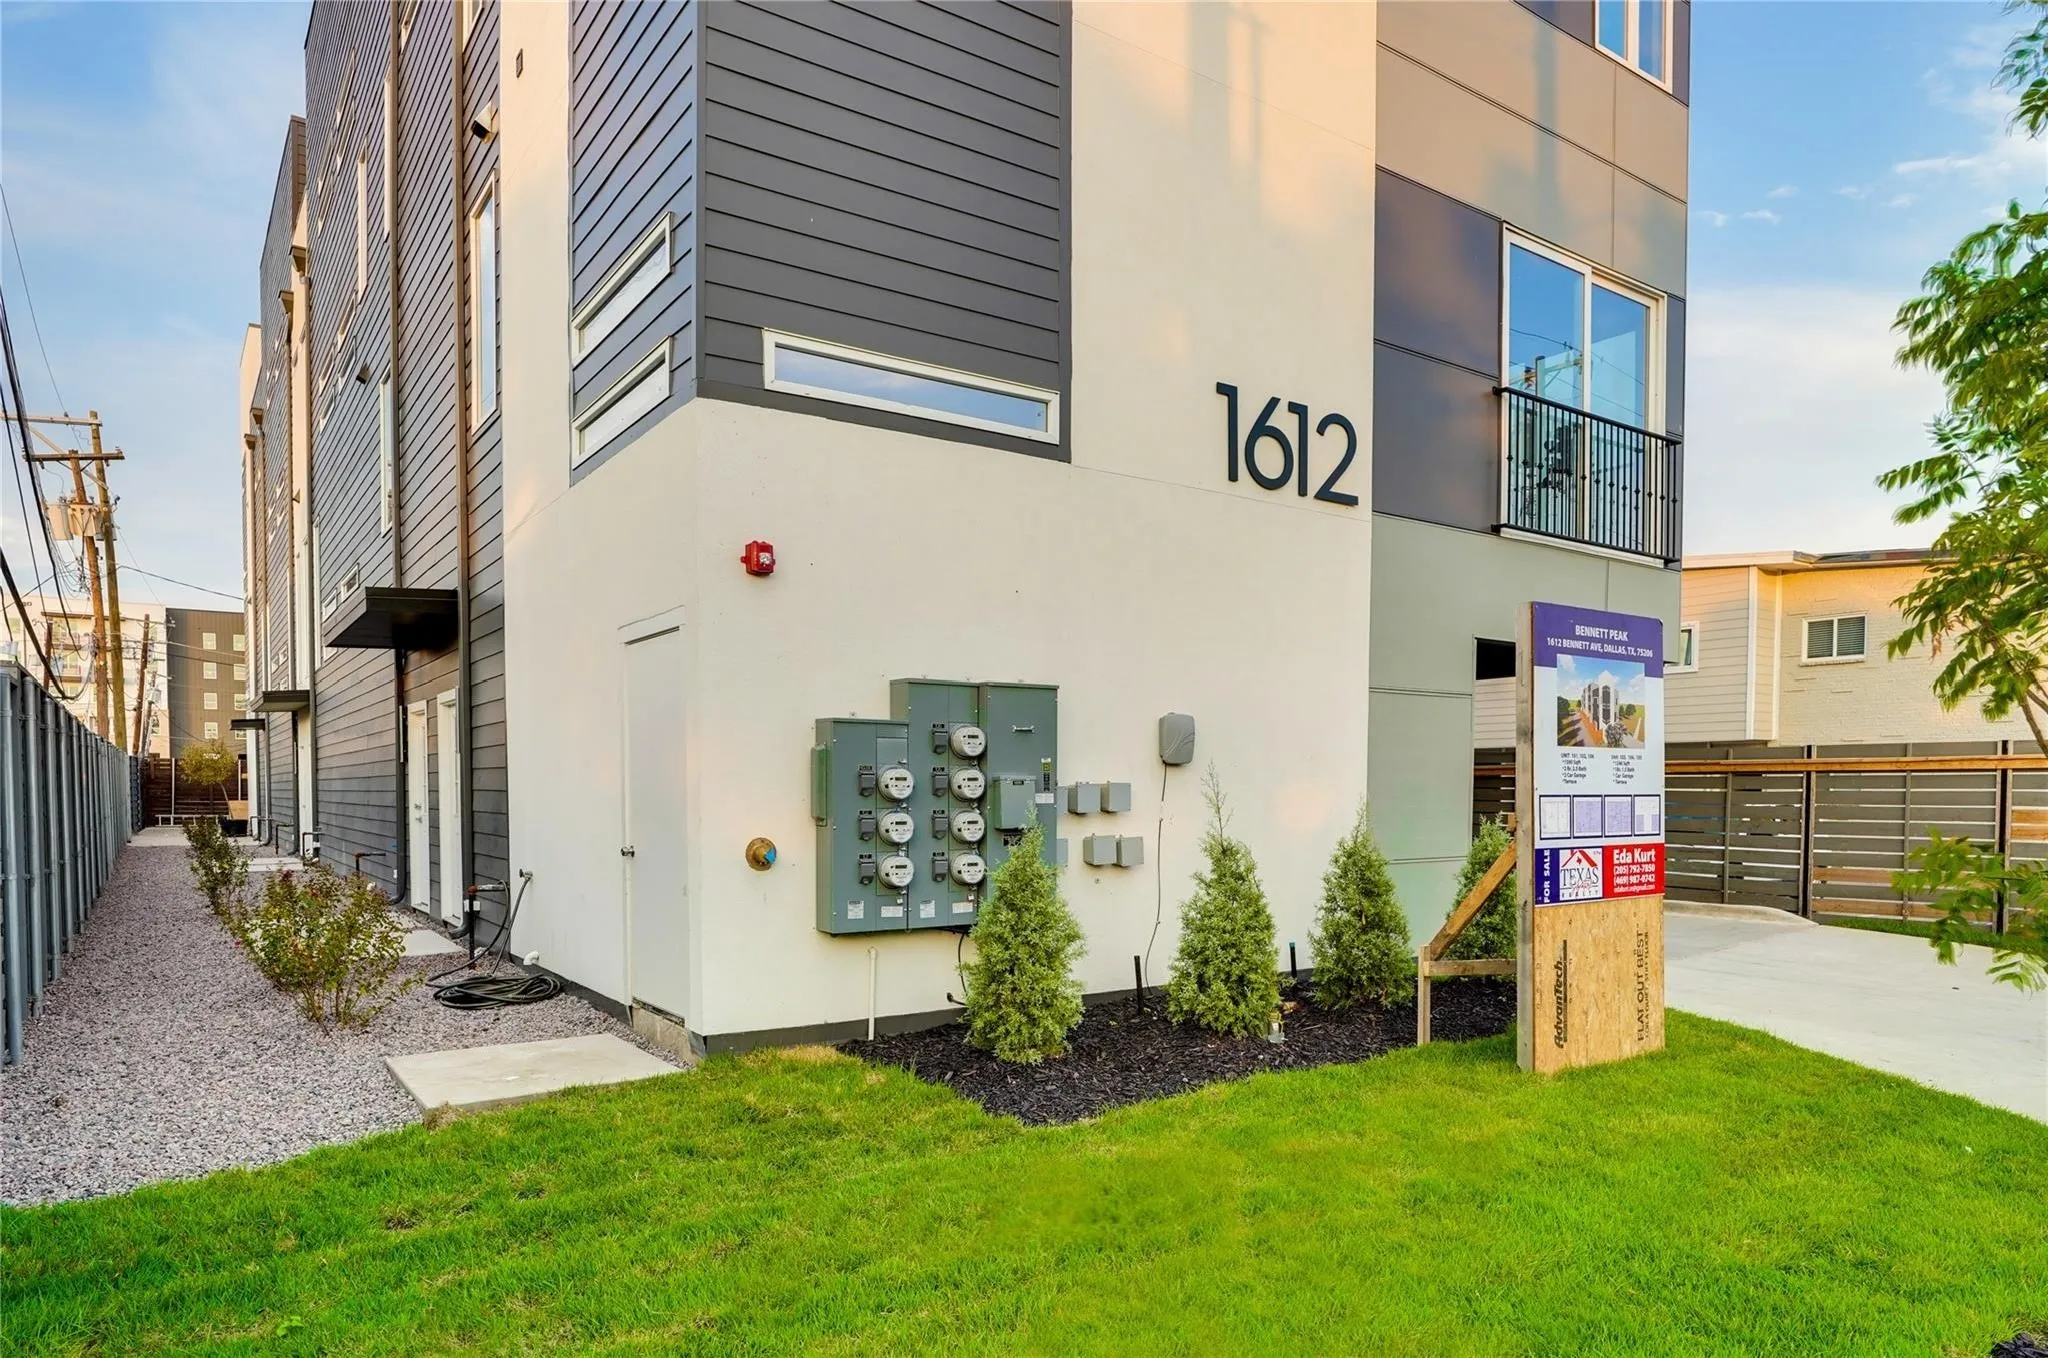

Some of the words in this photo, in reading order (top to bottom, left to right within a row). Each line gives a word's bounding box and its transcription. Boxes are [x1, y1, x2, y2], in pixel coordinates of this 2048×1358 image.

[1216, 381, 1359, 506] 1612
[1575, 624, 1608, 639] BENNETT
[1609, 629, 1629, 642] PEAK
[1547, 637, 1562, 648] 1612
[1562, 639, 1590, 651] BENNETT
[1590, 642, 1603, 653] AVE,
[1603, 644, 1627, 655] DALLAS,
[1627, 646, 1636, 657] TX,
[1543, 849, 1551, 877] SALE
[1613, 848, 1632, 865] Eda
[1633, 847, 1656, 863] Kurt
[1560, 866, 1600, 888] TEXAS
[1543, 880, 1551, 904] FOR
[1636, 971, 1645, 1004] OUT
[1553, 958, 1565, 1049] AdvanTech
[1636, 1005, 1645, 1041] FLAT
